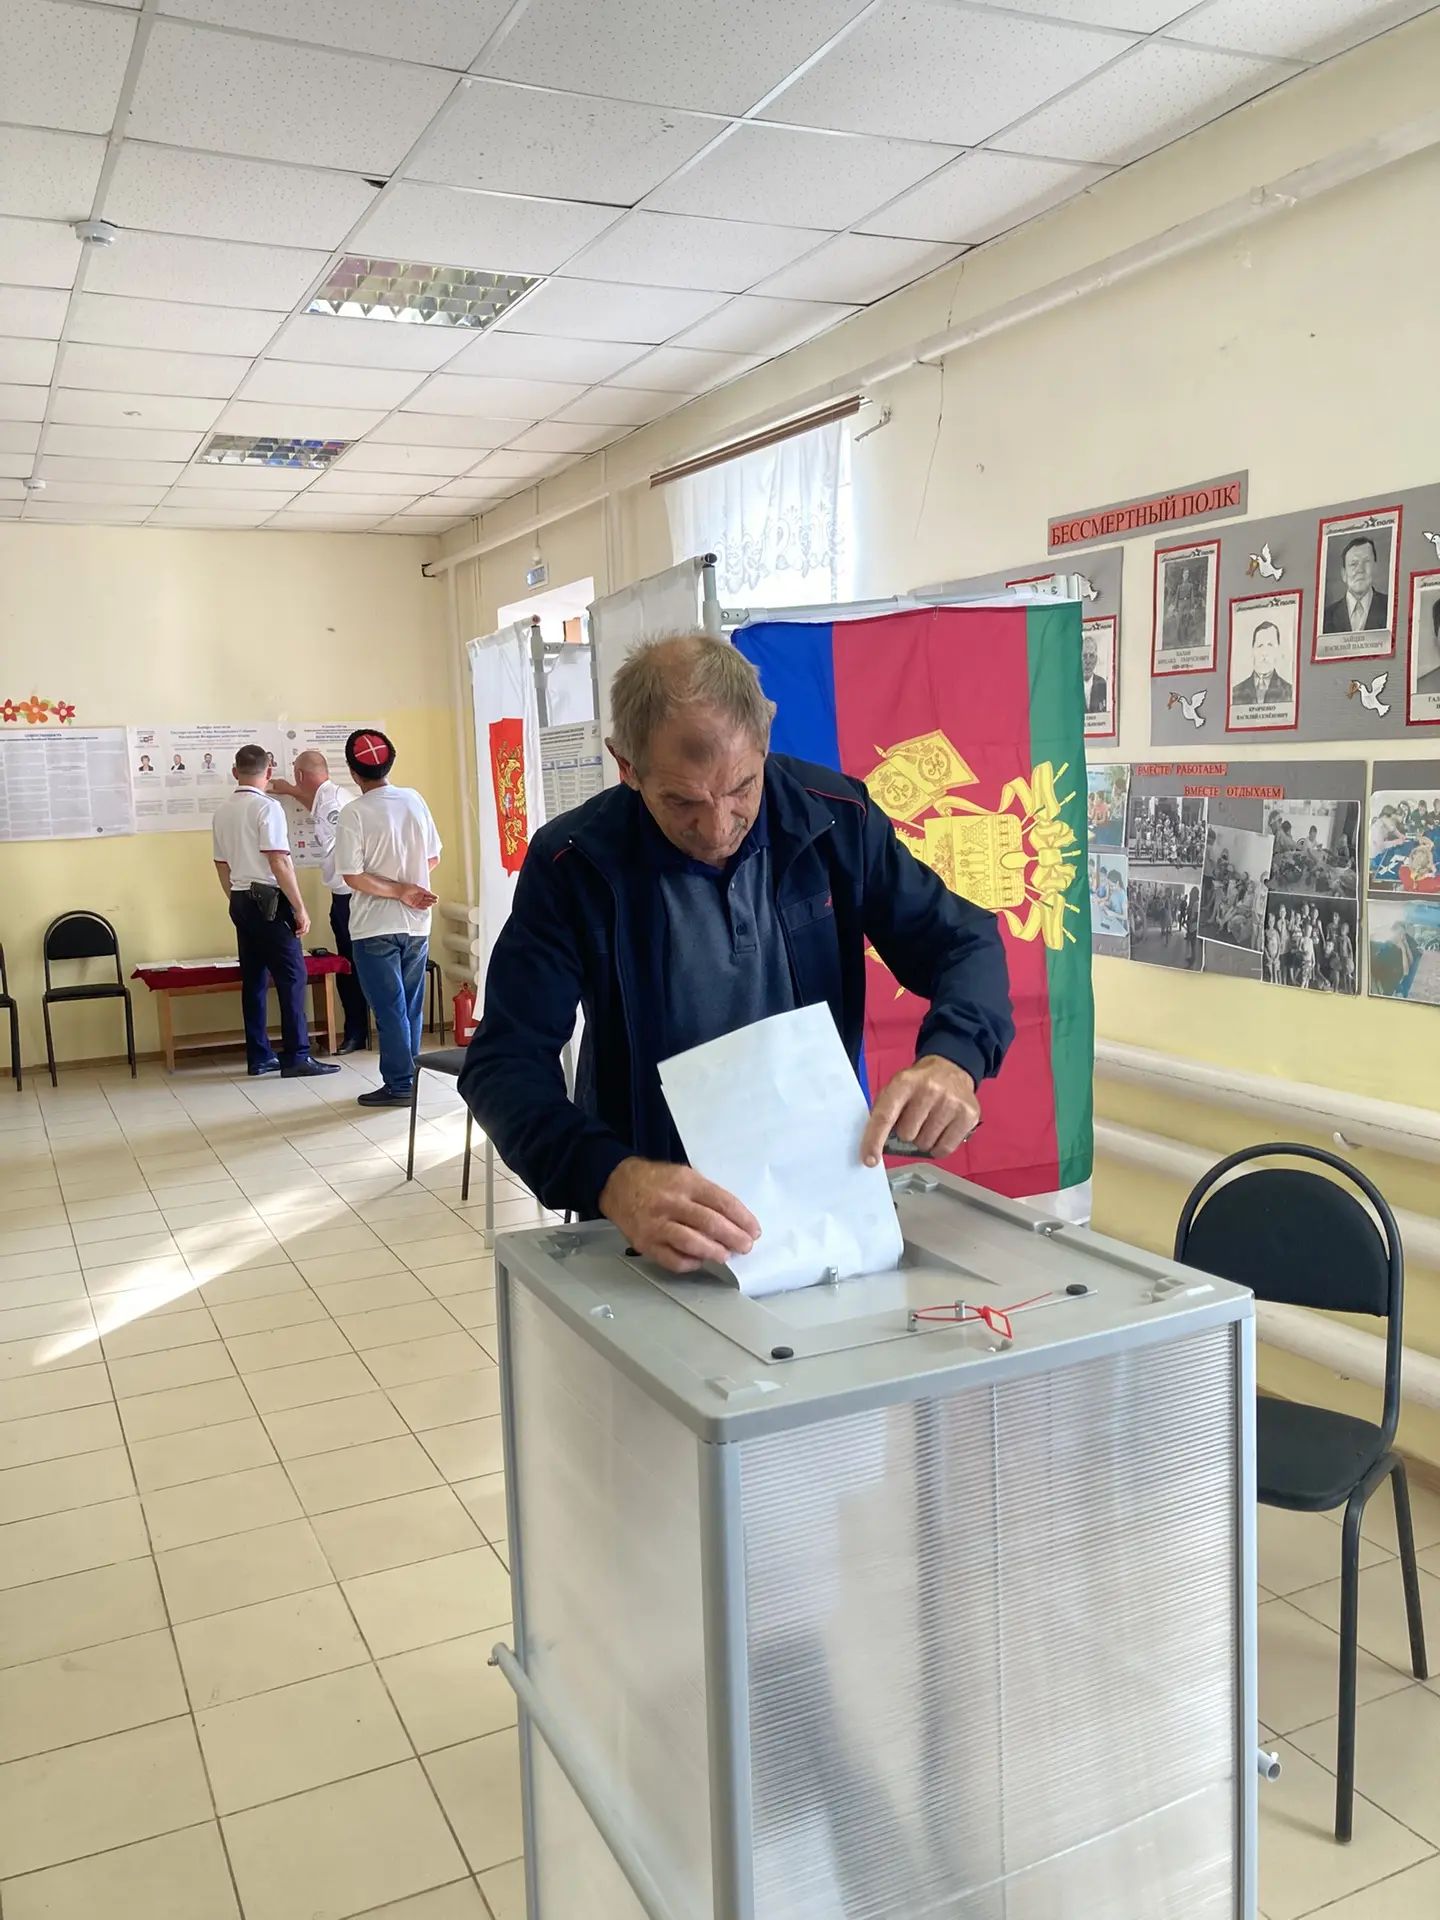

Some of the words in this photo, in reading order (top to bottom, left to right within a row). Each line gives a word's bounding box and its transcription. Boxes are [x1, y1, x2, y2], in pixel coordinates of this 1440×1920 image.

[1052, 495, 1176, 546] БЕССМЕРТНЫЙ
[1182, 485, 1237, 518] ПОЛК
[1138, 764, 1171, 776] ВМЕСТЕ
[1184, 785, 1219, 797] ВМЕСТЕ
[1227, 785, 1281, 798] ОТДЫХАЕМ
